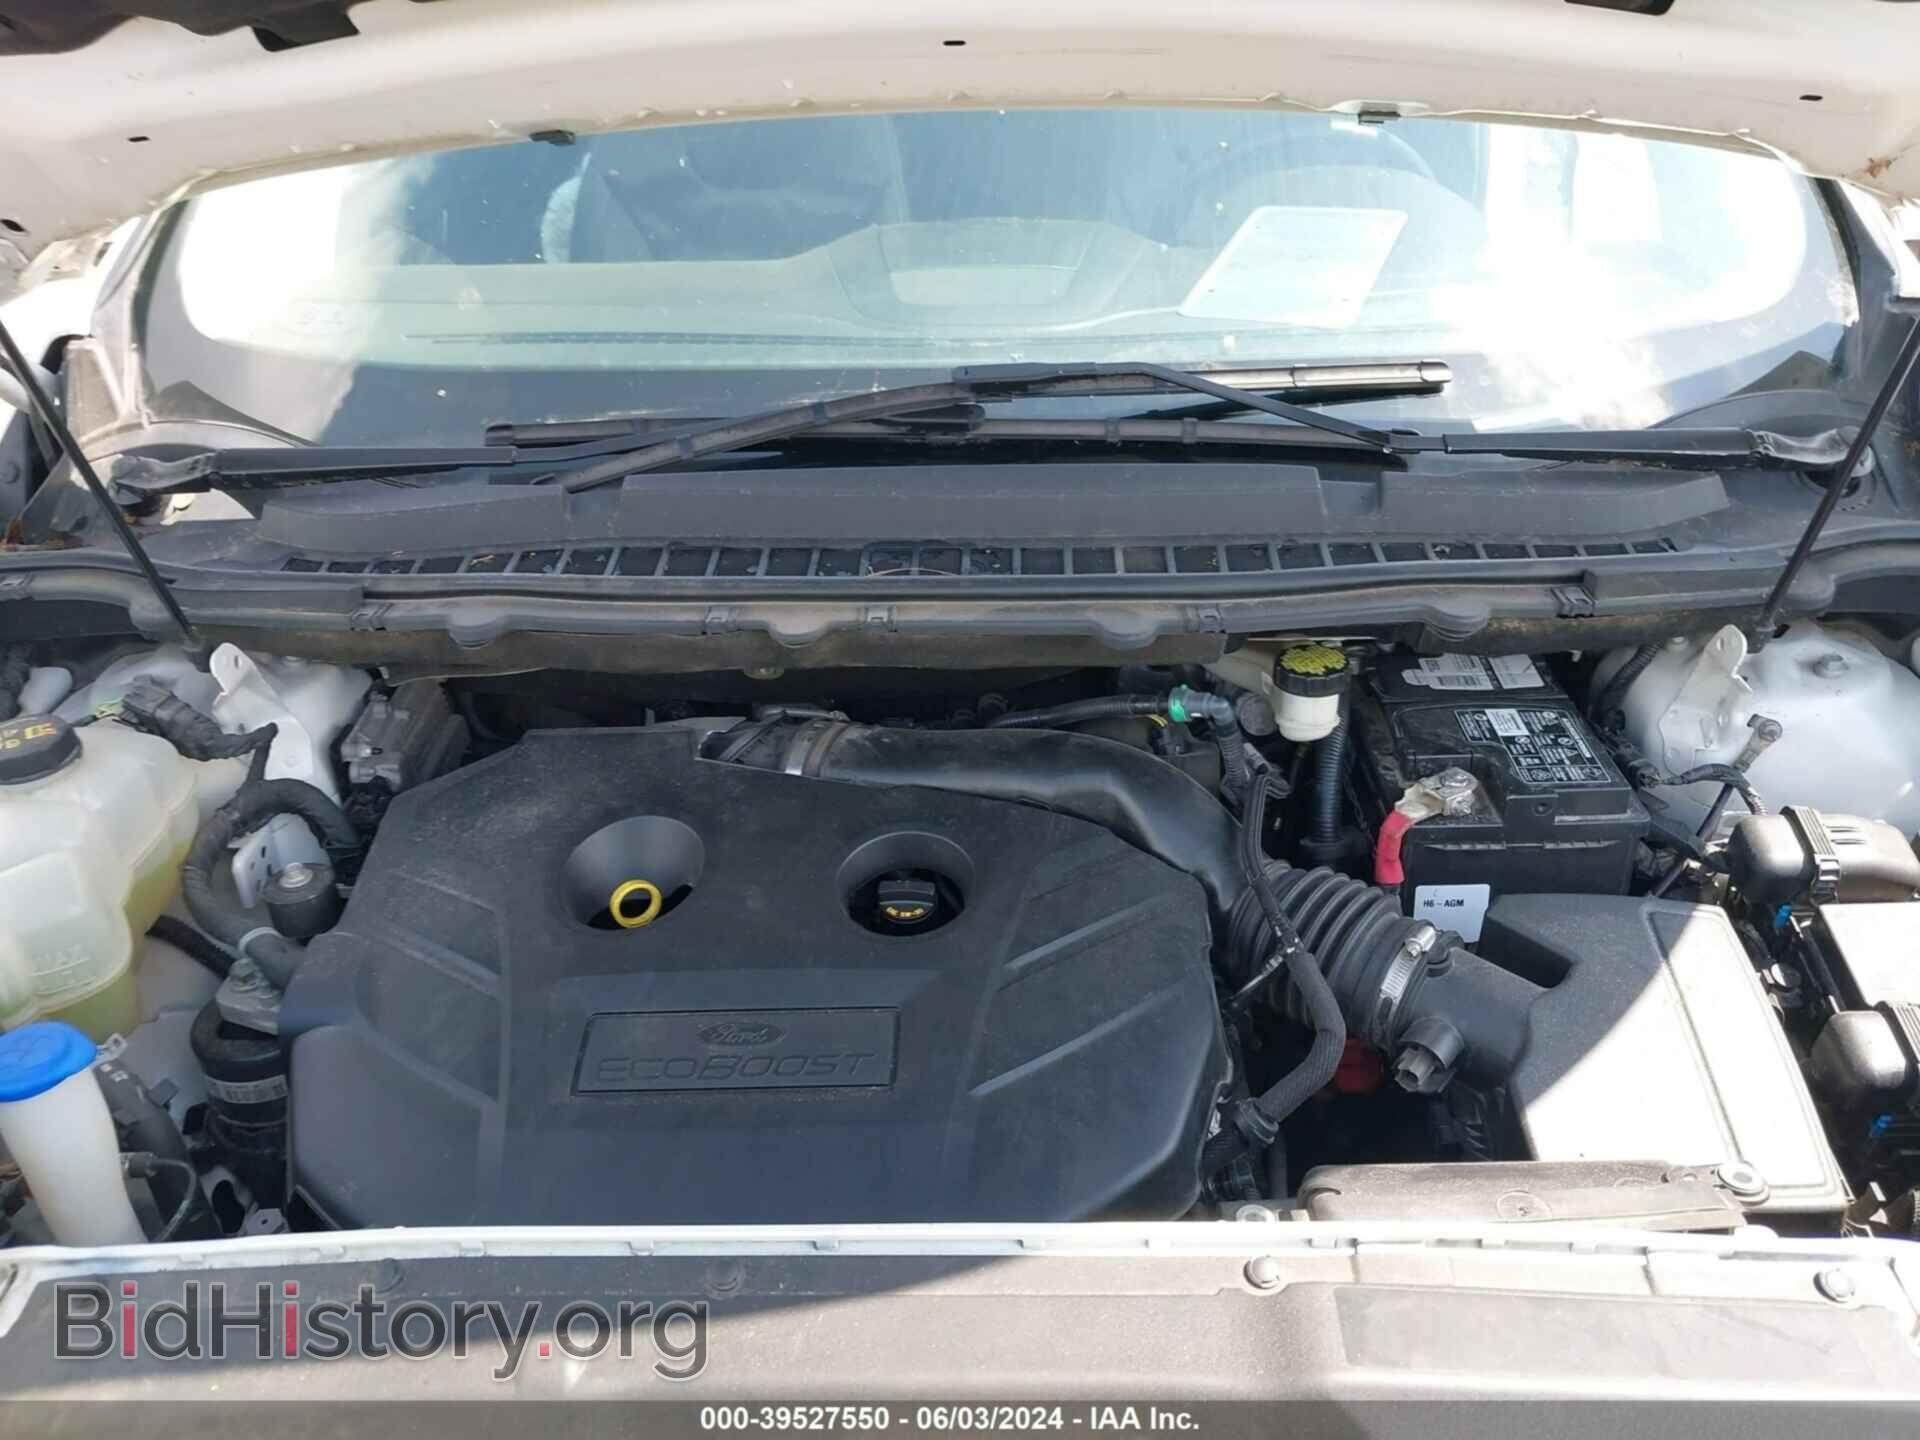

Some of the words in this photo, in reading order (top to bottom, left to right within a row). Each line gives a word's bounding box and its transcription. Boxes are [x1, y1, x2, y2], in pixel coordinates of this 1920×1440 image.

[1423, 898, 1434, 908] H6
[1443, 898, 1465, 908] AGM
[597, 1053, 876, 1082] ECOBOOST
